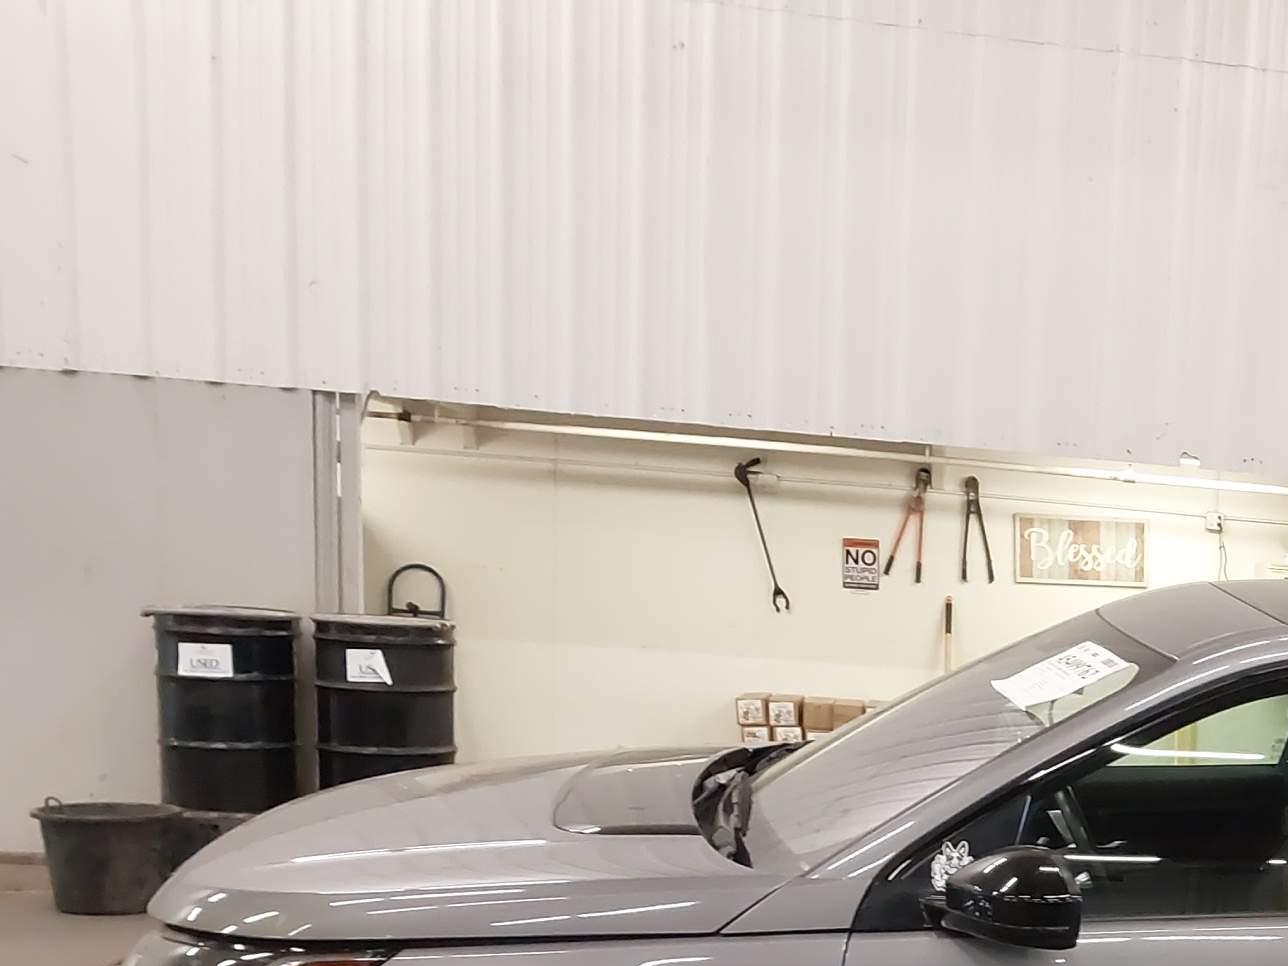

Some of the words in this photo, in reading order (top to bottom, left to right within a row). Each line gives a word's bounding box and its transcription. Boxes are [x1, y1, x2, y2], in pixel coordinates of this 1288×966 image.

[1024, 527, 1142, 571] Blessed
[845, 549, 877, 566] NO
[845, 566, 877, 575] STUPID
[844, 574, 877, 583] PEOPLE
[189, 658, 220, 669] USED
